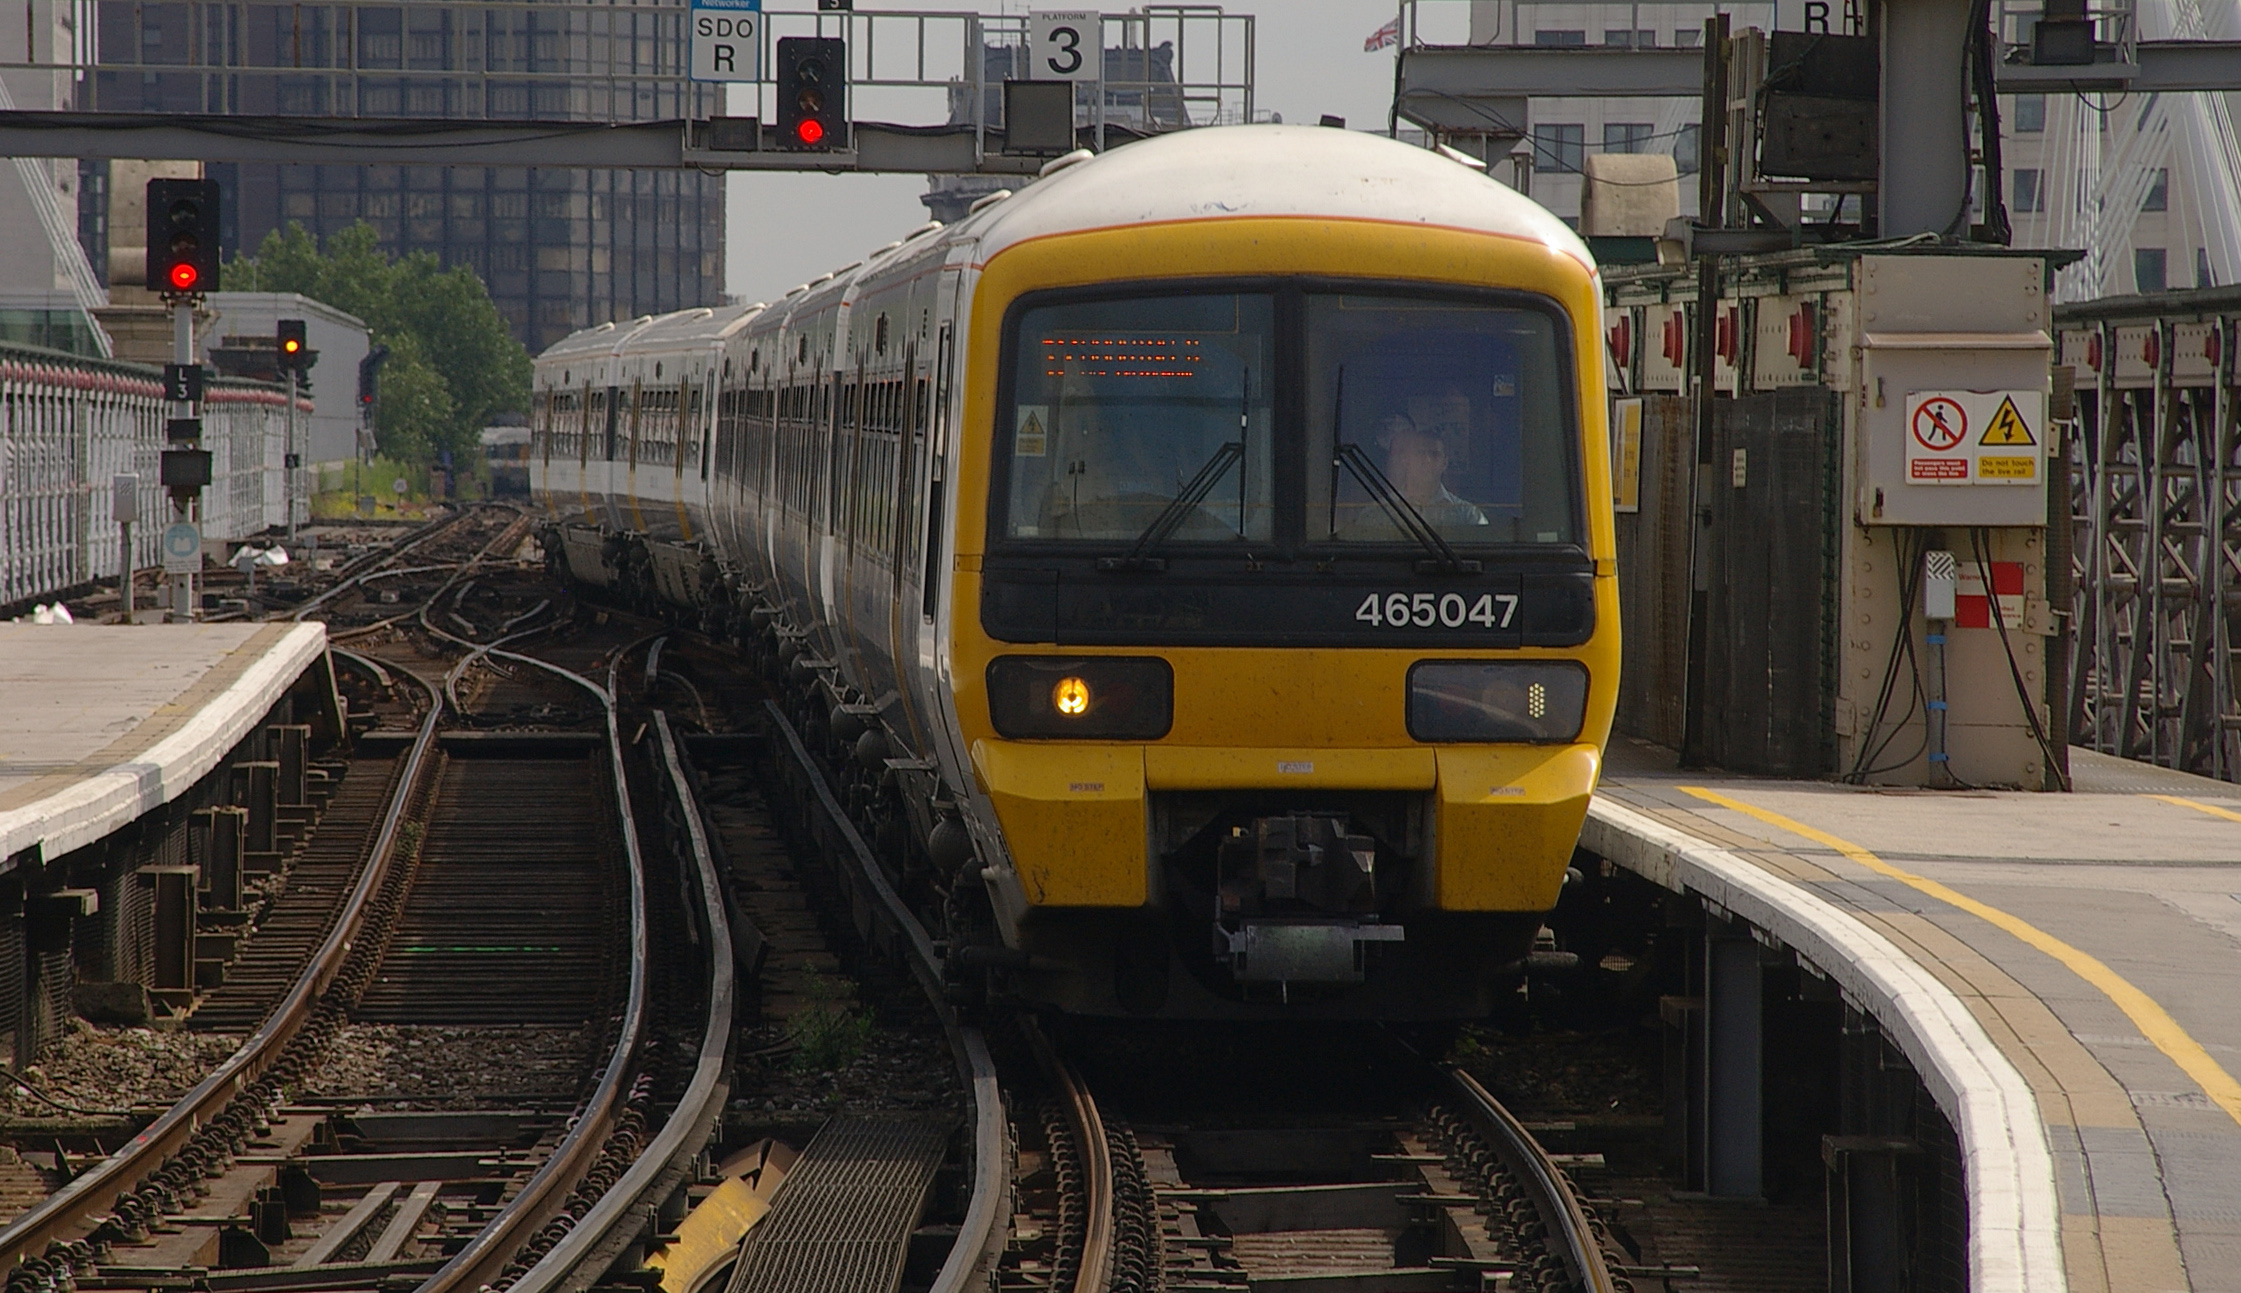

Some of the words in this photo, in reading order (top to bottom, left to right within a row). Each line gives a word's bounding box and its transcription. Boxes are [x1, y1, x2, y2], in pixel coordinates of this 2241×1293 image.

[698, 18, 753, 38] SDO
[1805, 2, 1829, 34] R
[714, 44, 735, 72] R
[1047, 26, 1082, 74] 3
[179, 367, 187, 381] L
[178, 383, 188, 398] 3
[1982, 459, 1993, 467] Do
[2012, 459, 2034, 467] touch
[1356, 593, 1518, 628] 465047
